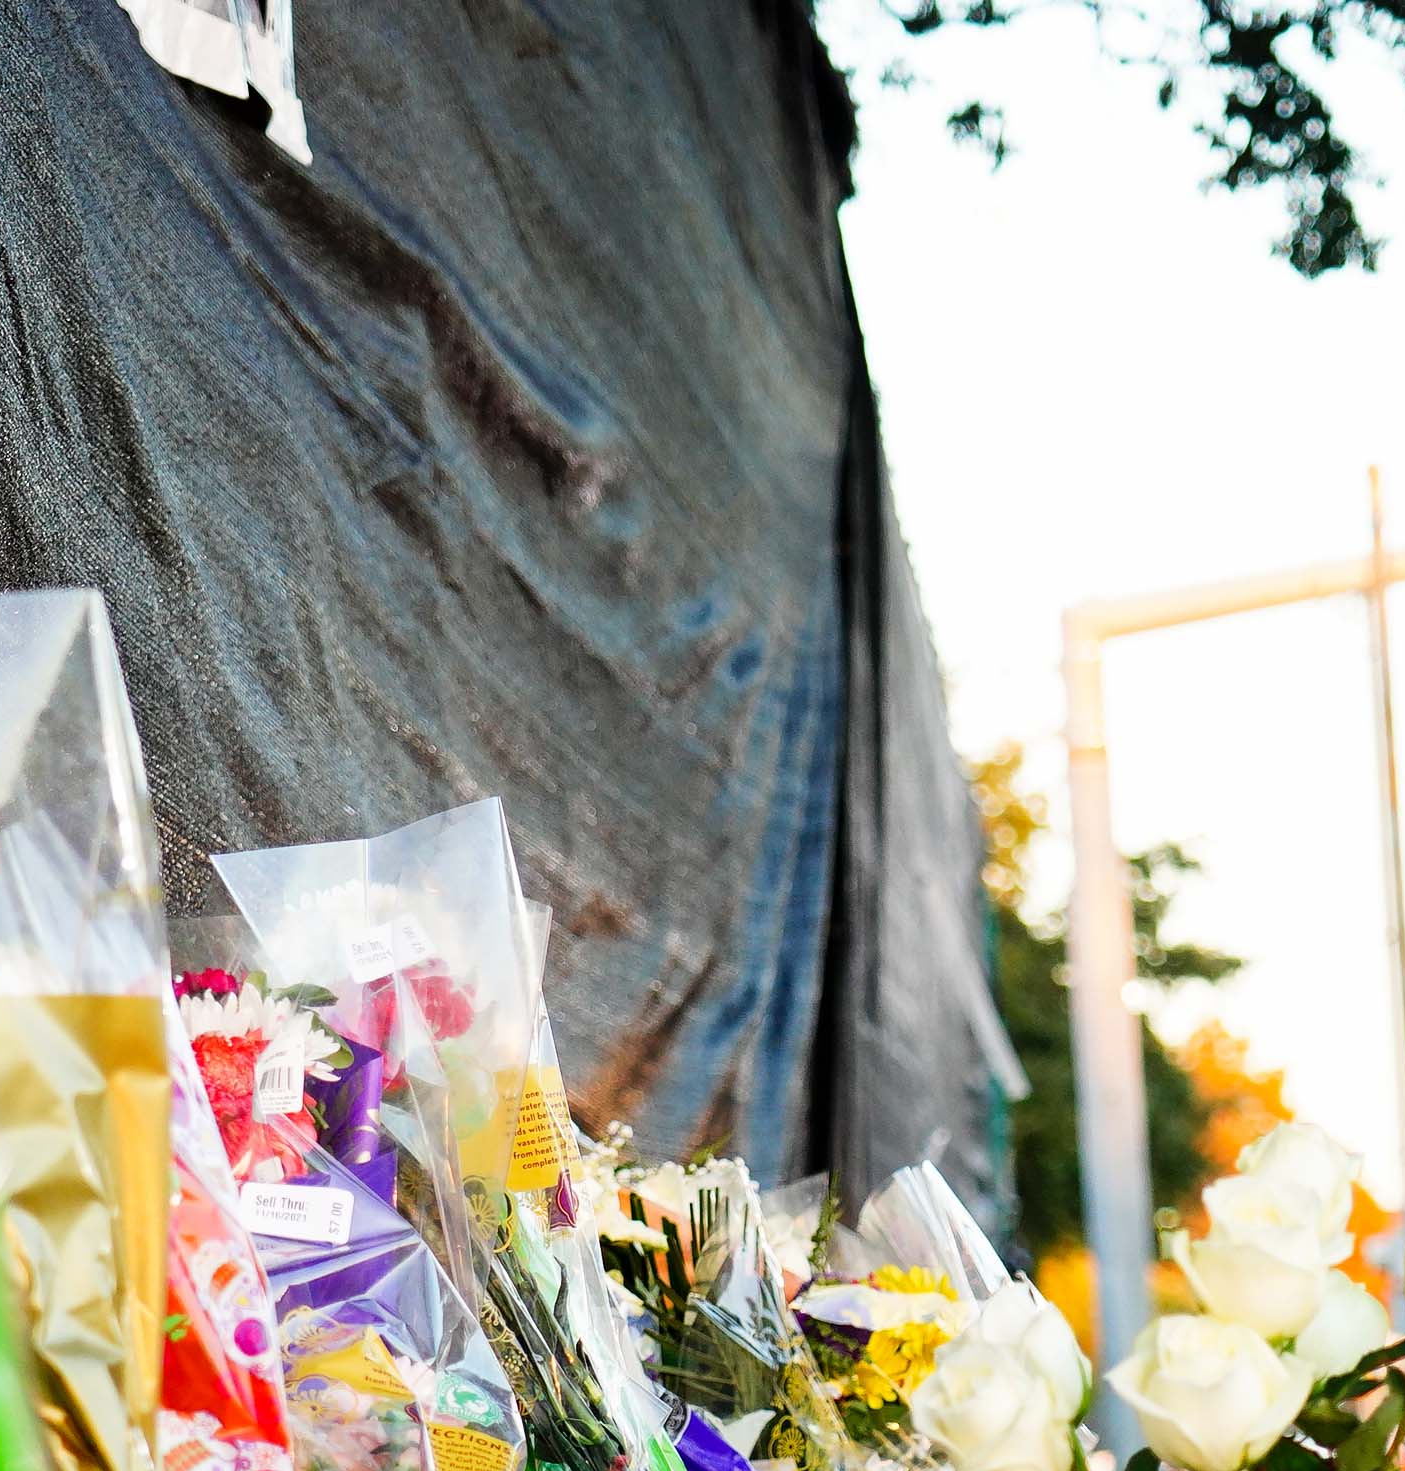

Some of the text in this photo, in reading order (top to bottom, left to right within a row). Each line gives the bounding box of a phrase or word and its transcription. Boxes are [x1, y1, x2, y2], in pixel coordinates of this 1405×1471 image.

[525, 1091, 539, 1099] one
[520, 1102, 541, 1112] water
[523, 1114, 536, 1123] fall
[529, 1124, 546, 1133] with
[517, 1139, 535, 1148] vase
[513, 1149, 533, 1160] from
[535, 1146, 552, 1156] heat
[256, 1194, 276, 1208] Sell
